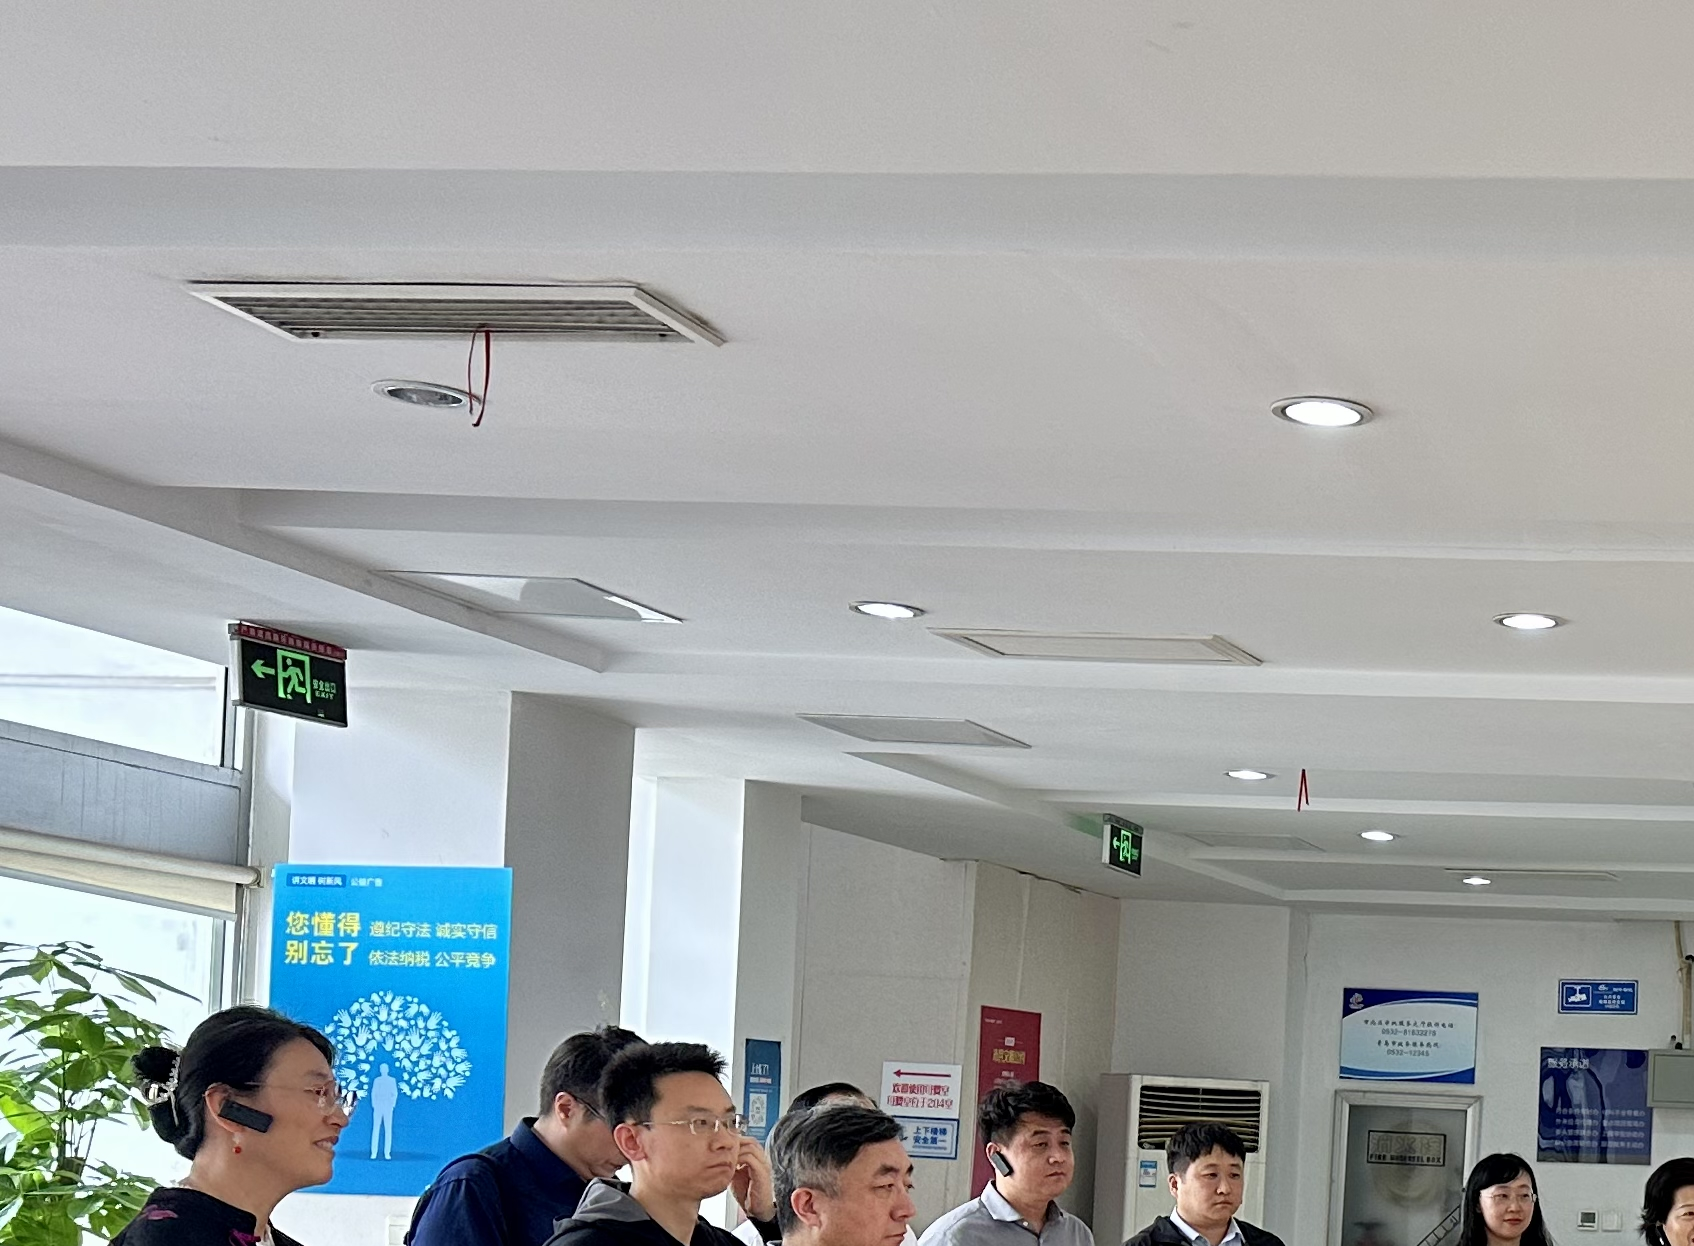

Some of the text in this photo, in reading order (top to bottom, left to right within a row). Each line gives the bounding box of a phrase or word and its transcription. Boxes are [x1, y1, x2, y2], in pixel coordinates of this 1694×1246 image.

[286, 911, 361, 937] 您懂得
[369, 921, 497, 939] 遵纪守法 诚实守信
[285, 940, 359, 965] 别忘了
[369, 950, 496, 968] 依法纳税 公平竞争
